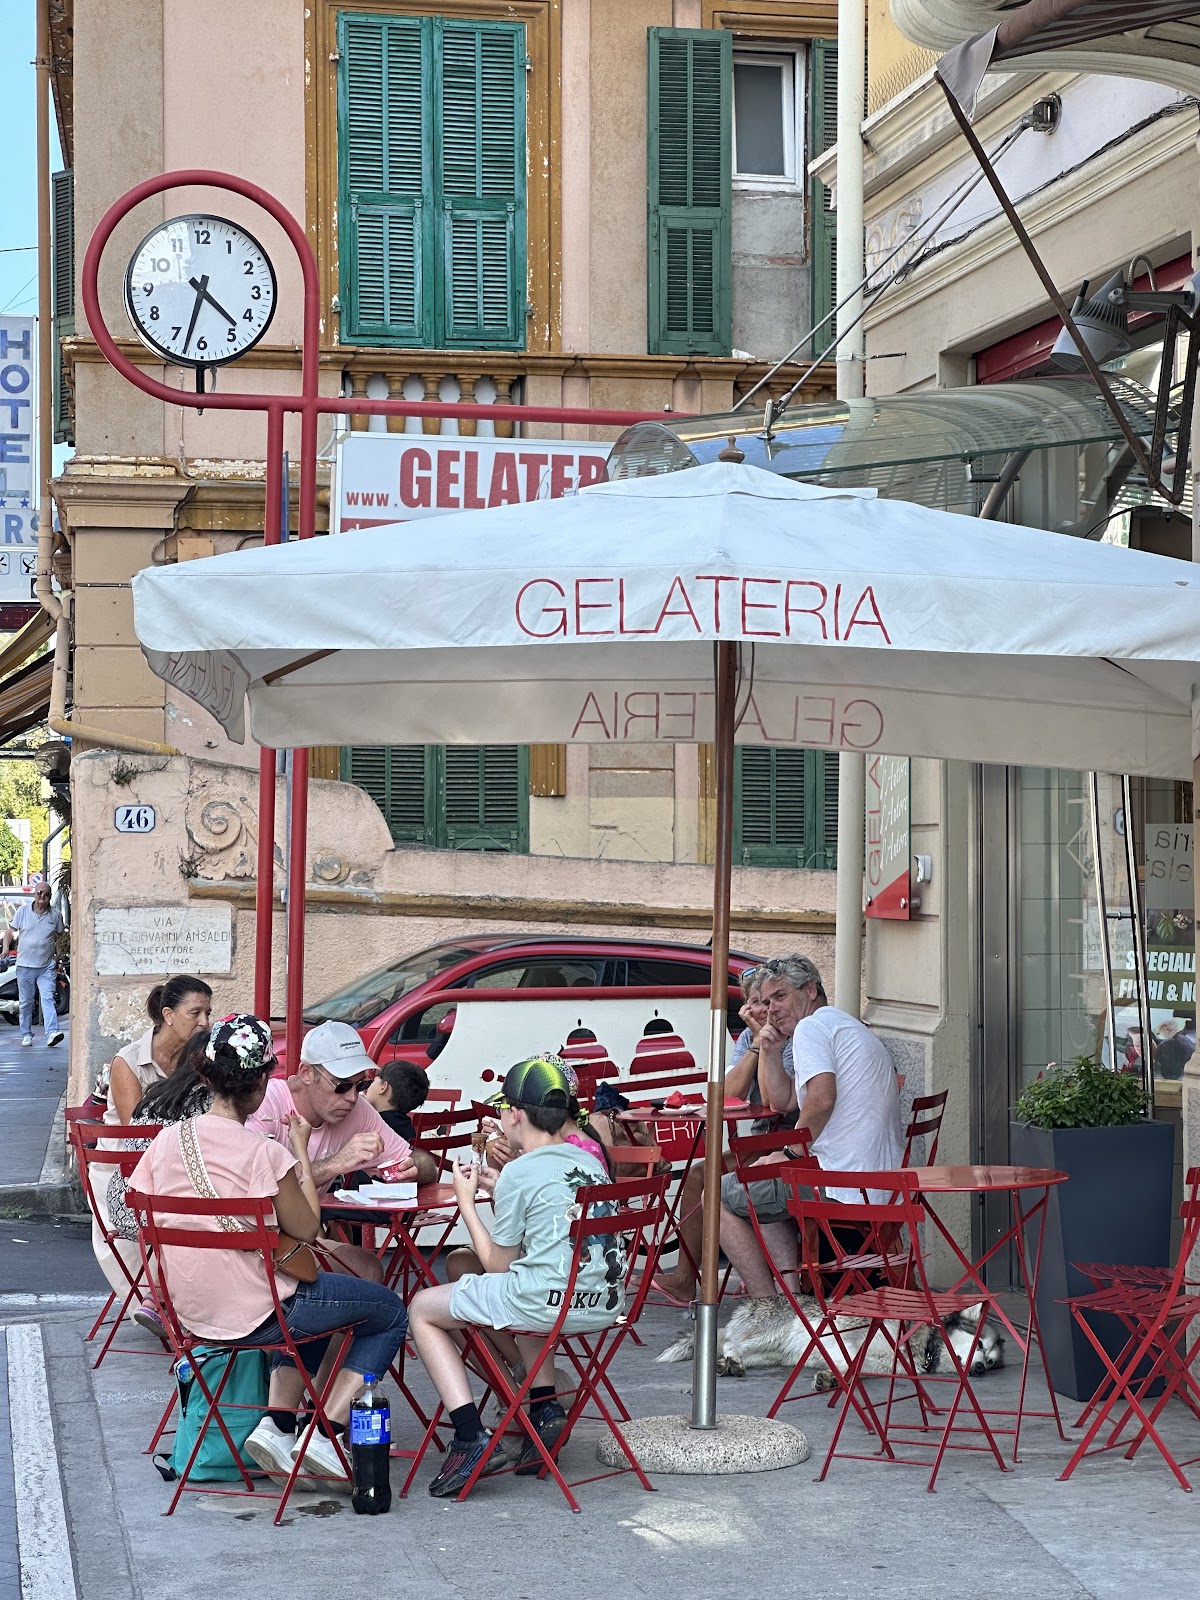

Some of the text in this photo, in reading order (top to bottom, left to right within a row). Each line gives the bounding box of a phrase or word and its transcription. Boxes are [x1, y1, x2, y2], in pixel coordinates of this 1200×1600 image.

[194, 230, 211, 245] 12
[171, 238, 183, 253] 11
[225, 240, 232, 254] 1
[150, 258, 171, 273] 10
[243, 261, 254, 275] 2
[142, 282, 154, 297] 9
[251, 285, 262, 300] 3
[149, 305, 160, 321] 8
[242, 308, 254, 323] 4
[171, 326, 183, 341] 7
[226, 328, 237, 343] 5
[196, 336, 208, 351] 6
[0, 330, 31, 498] HOTEL
[515, 575, 892, 645] GELATERIA
[121, 809, 149, 829] 46
[868, 754, 882, 886] GELA
[153, 916, 173, 927] VIA
[131, 946, 194, 955] BENEFATTORE
[1166, 983, 1179, 1002] &
